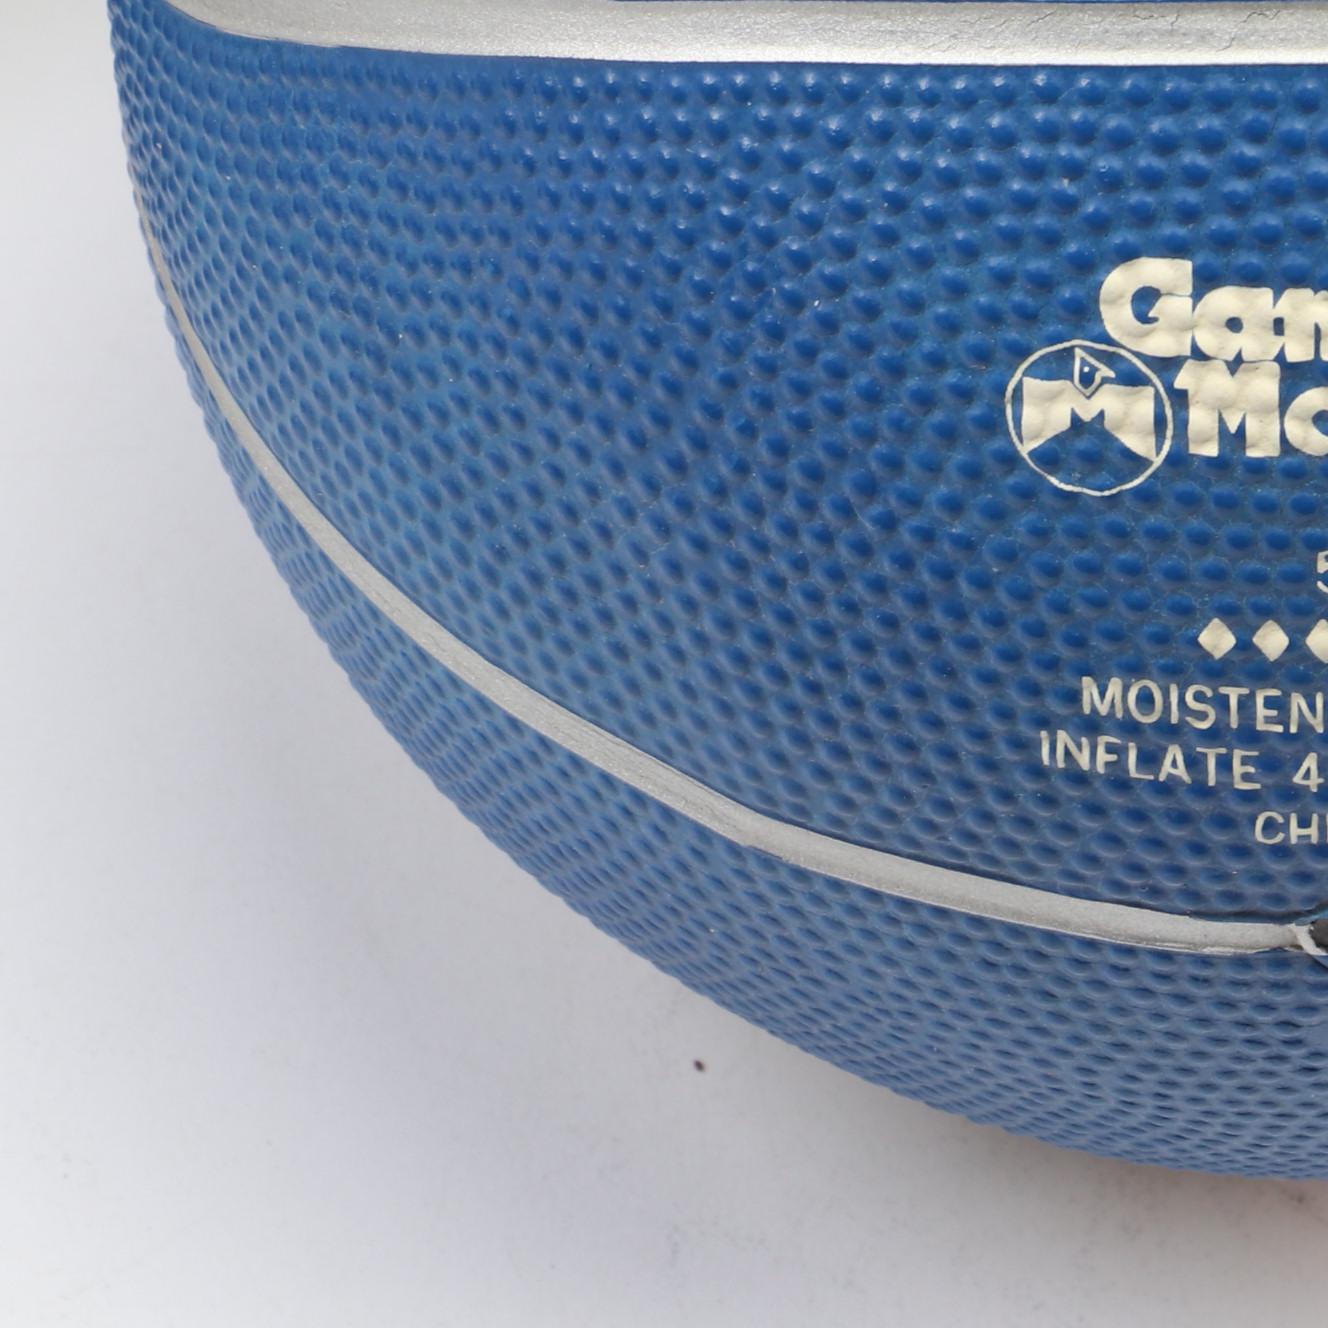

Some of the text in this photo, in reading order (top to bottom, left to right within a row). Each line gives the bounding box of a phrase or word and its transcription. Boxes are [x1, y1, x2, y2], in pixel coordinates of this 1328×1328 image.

[1081, 675, 1326, 735] MOISTEN
[1039, 729, 1261, 791] INFLATE
[1293, 751, 1325, 793] 4
